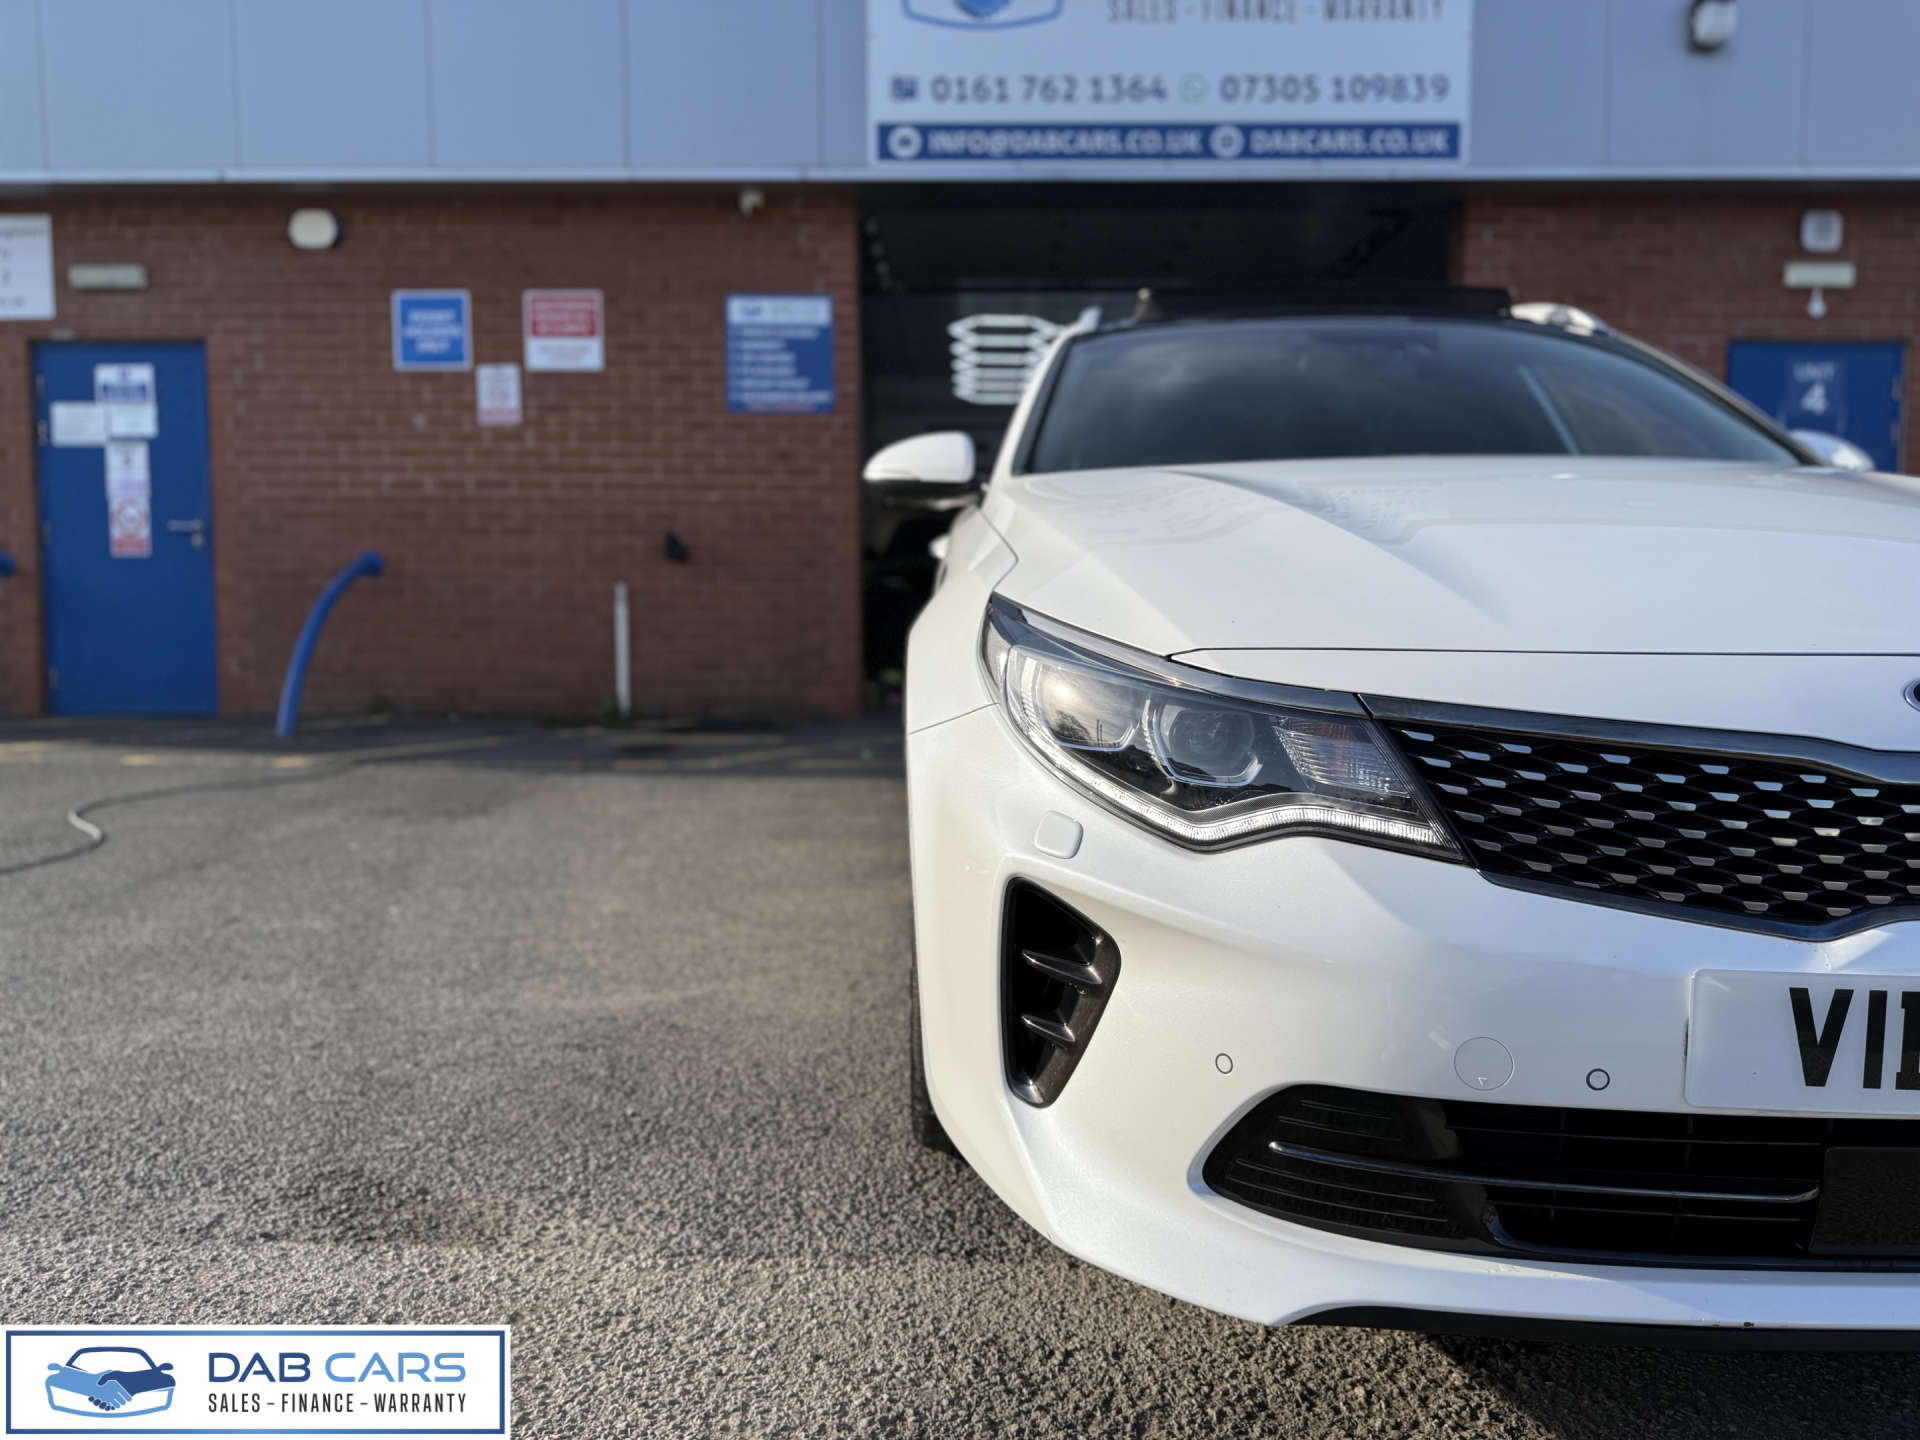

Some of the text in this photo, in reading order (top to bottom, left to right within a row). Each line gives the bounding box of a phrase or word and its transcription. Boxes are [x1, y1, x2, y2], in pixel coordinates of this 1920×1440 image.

[930, 76, 1167, 103] 0161 762 1364
[1219, 75, 1450, 103] 07305 109839
[928, 129, 1203, 156] INFO@DABCARS.CO.UK
[1249, 128, 1451, 155] DABCARS.CO.UK
[1800, 382, 1828, 415] 4
